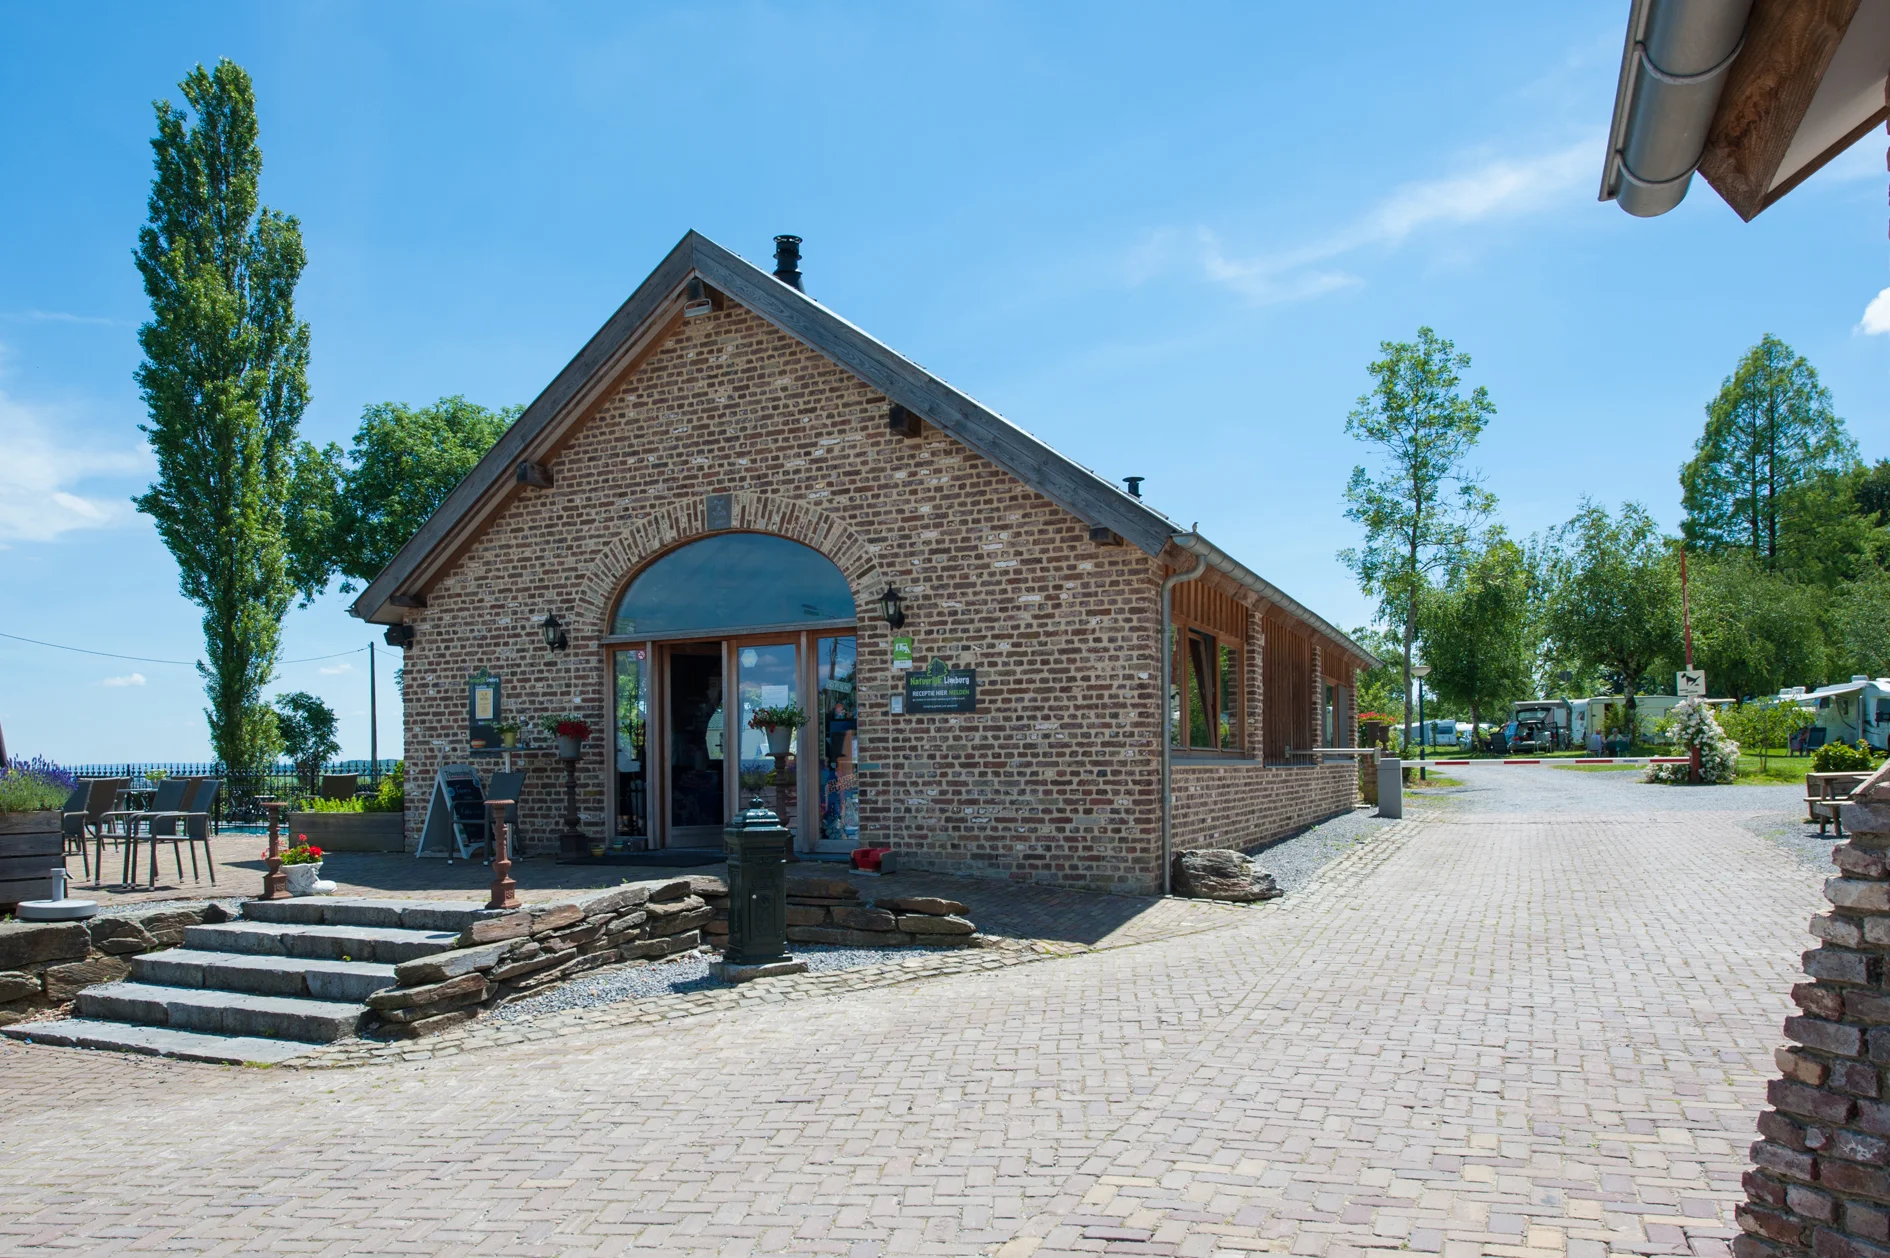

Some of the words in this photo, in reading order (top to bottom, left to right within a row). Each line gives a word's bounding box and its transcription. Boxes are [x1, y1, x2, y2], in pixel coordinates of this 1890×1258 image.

[943, 676, 970, 685] Limburg
[828, 681, 850, 692] OPEN
[948, 688, 970, 696] MELDEN
